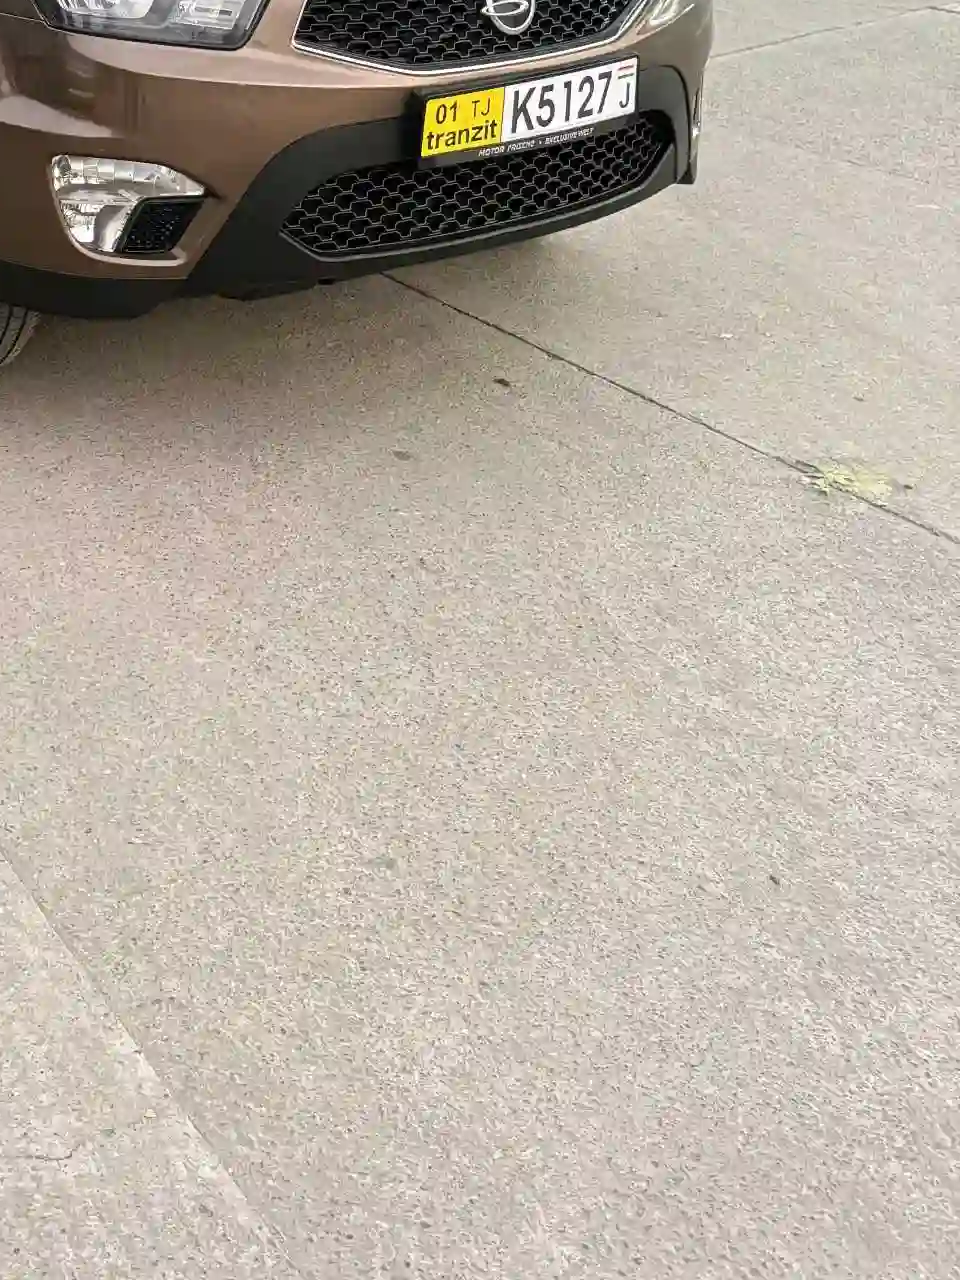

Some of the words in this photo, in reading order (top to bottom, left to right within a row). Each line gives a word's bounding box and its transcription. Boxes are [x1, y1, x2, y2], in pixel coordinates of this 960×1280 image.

[435, 99, 457, 124] 01
[471, 98, 491, 118] TJ
[511, 70, 613, 134] K5127
[427, 119, 498, 150] tranzit
[478, 145, 505, 157] MOTOR
